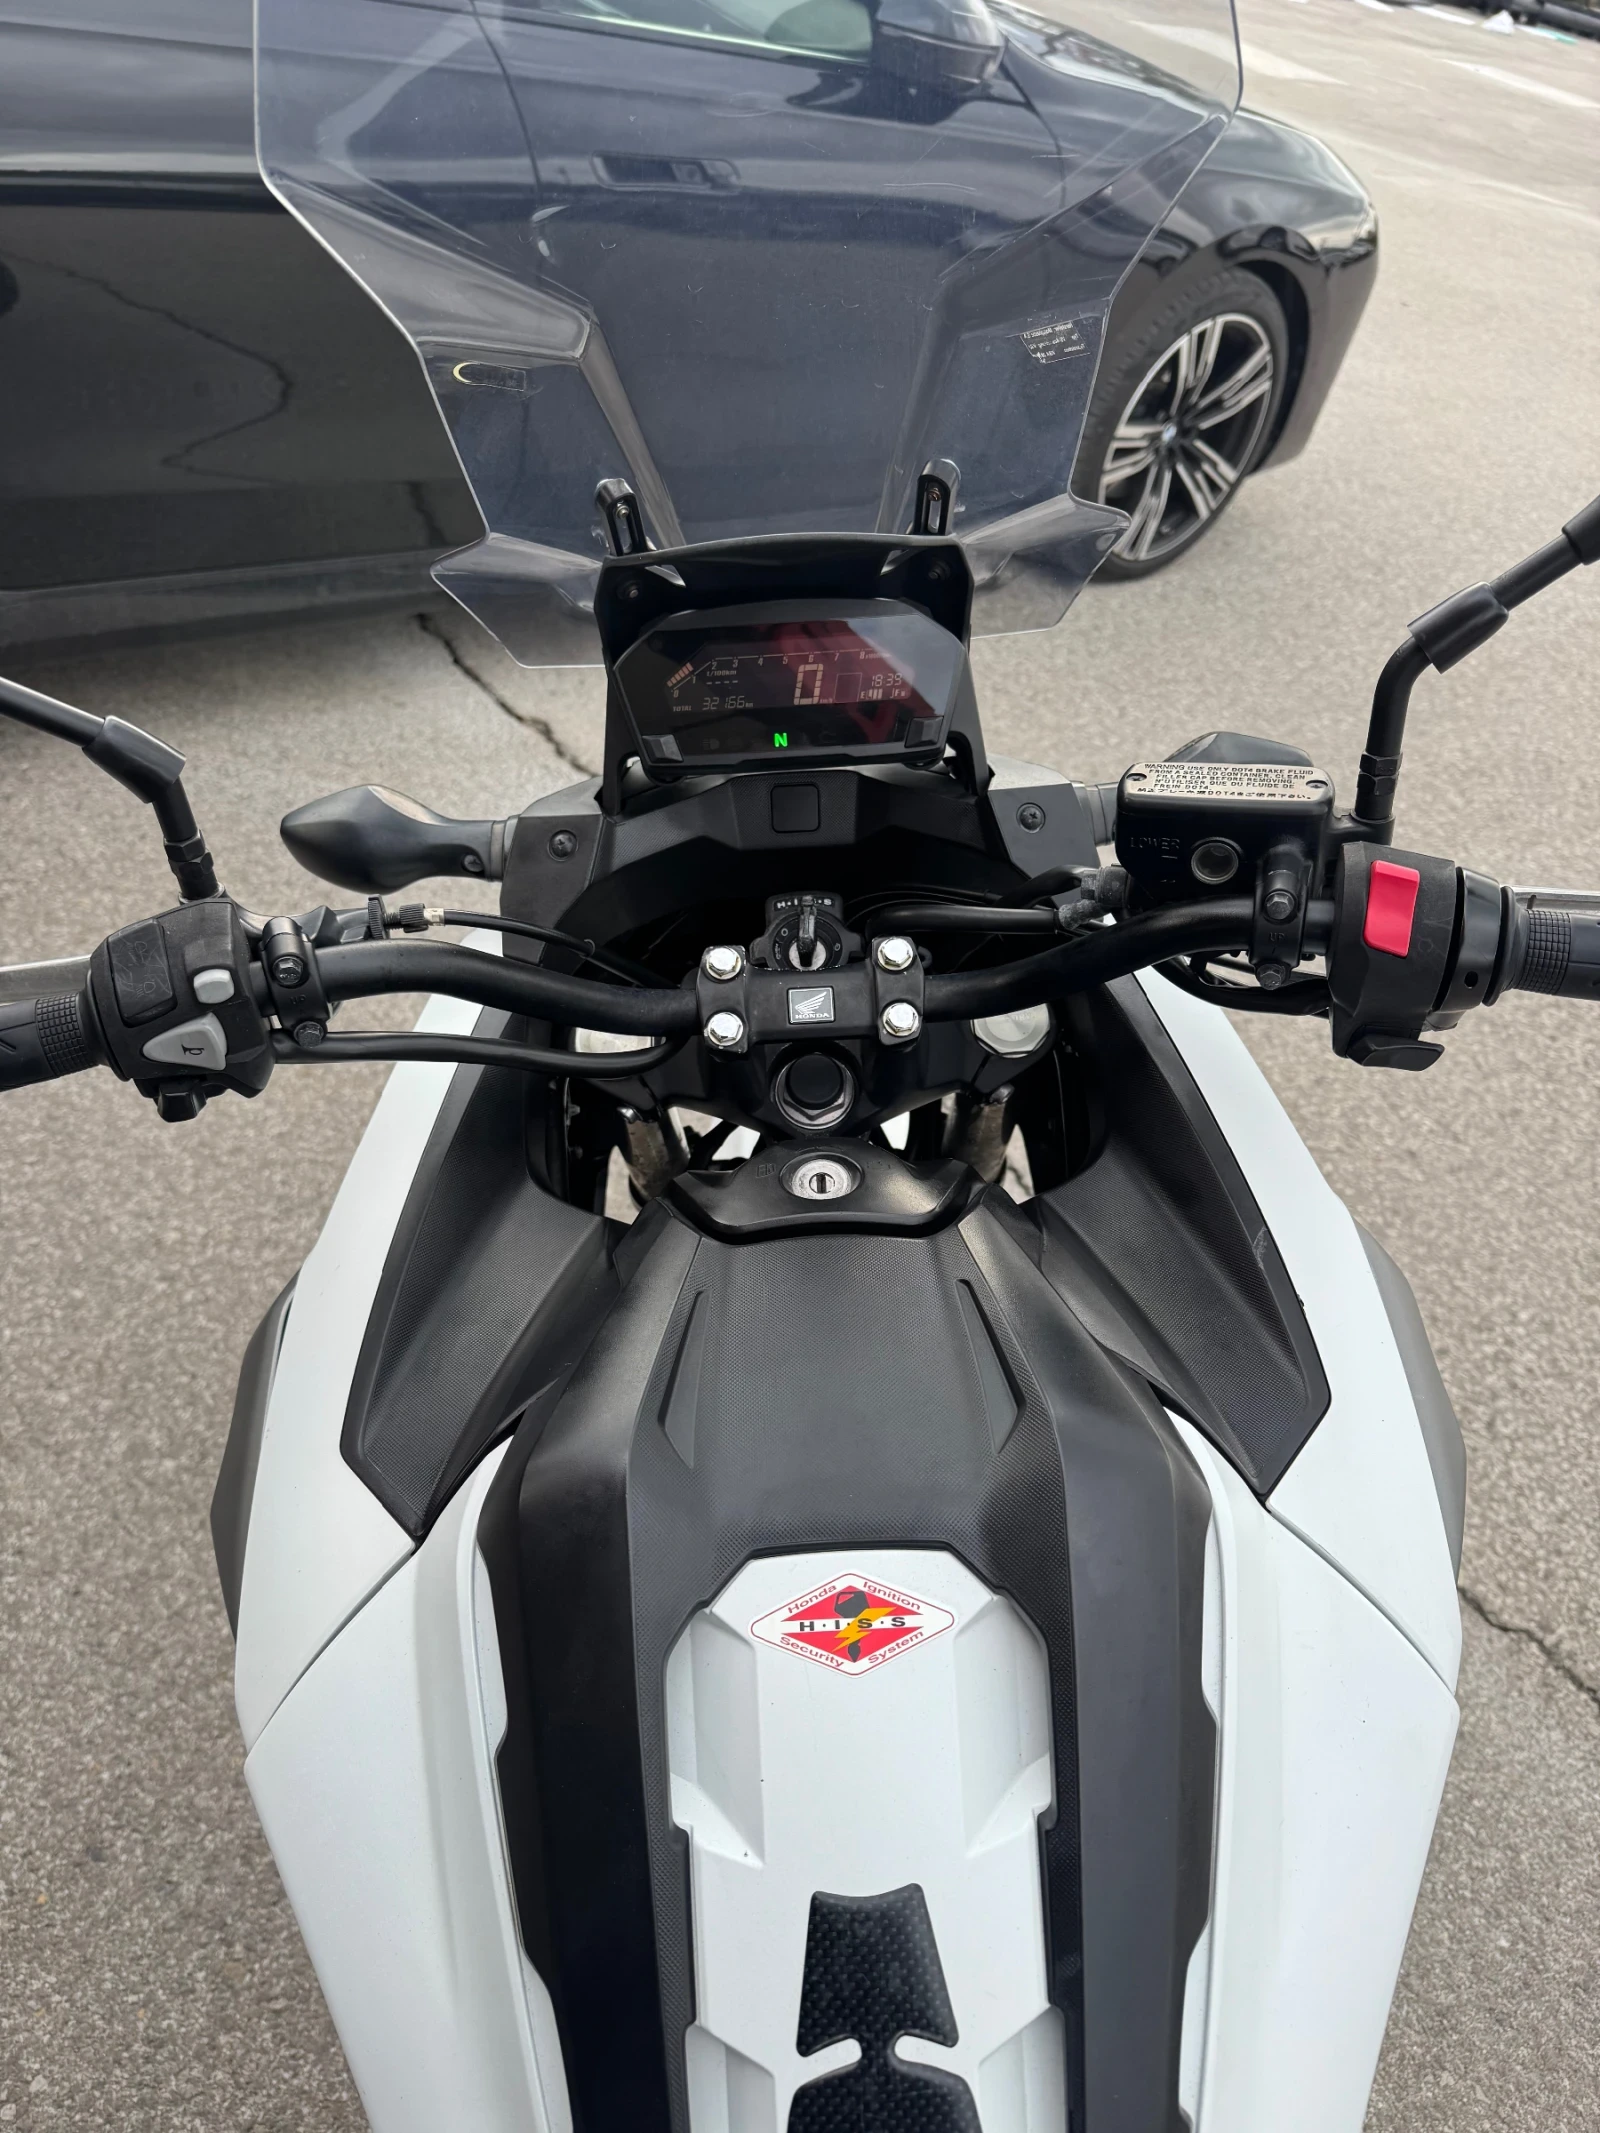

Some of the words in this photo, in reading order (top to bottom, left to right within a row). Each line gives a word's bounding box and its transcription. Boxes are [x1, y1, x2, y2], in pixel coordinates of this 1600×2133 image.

[711, 661, 717, 670] 2
[732, 659, 739, 668] 3
[757, 657, 764, 666] 4
[783, 656, 788, 665] 5
[808, 655, 814, 663] 6
[834, 653, 839, 661] 7
[859, 651, 865, 660] 8
[793, 663, 824, 706] 0
[871, 672, 903, 687] 18:39
[860, 691, 867, 699] E
[894, 688, 901, 697] F
[774, 732, 788, 748] N
[1144, 763, 1185, 771] WARNING
[795, 1012, 831, 1020] HONDA
[787, 1584, 838, 1614] Honda
[862, 1581, 921, 1611] Ignition
[779, 1636, 845, 1668] Security
[867, 1630, 925, 1664] System
